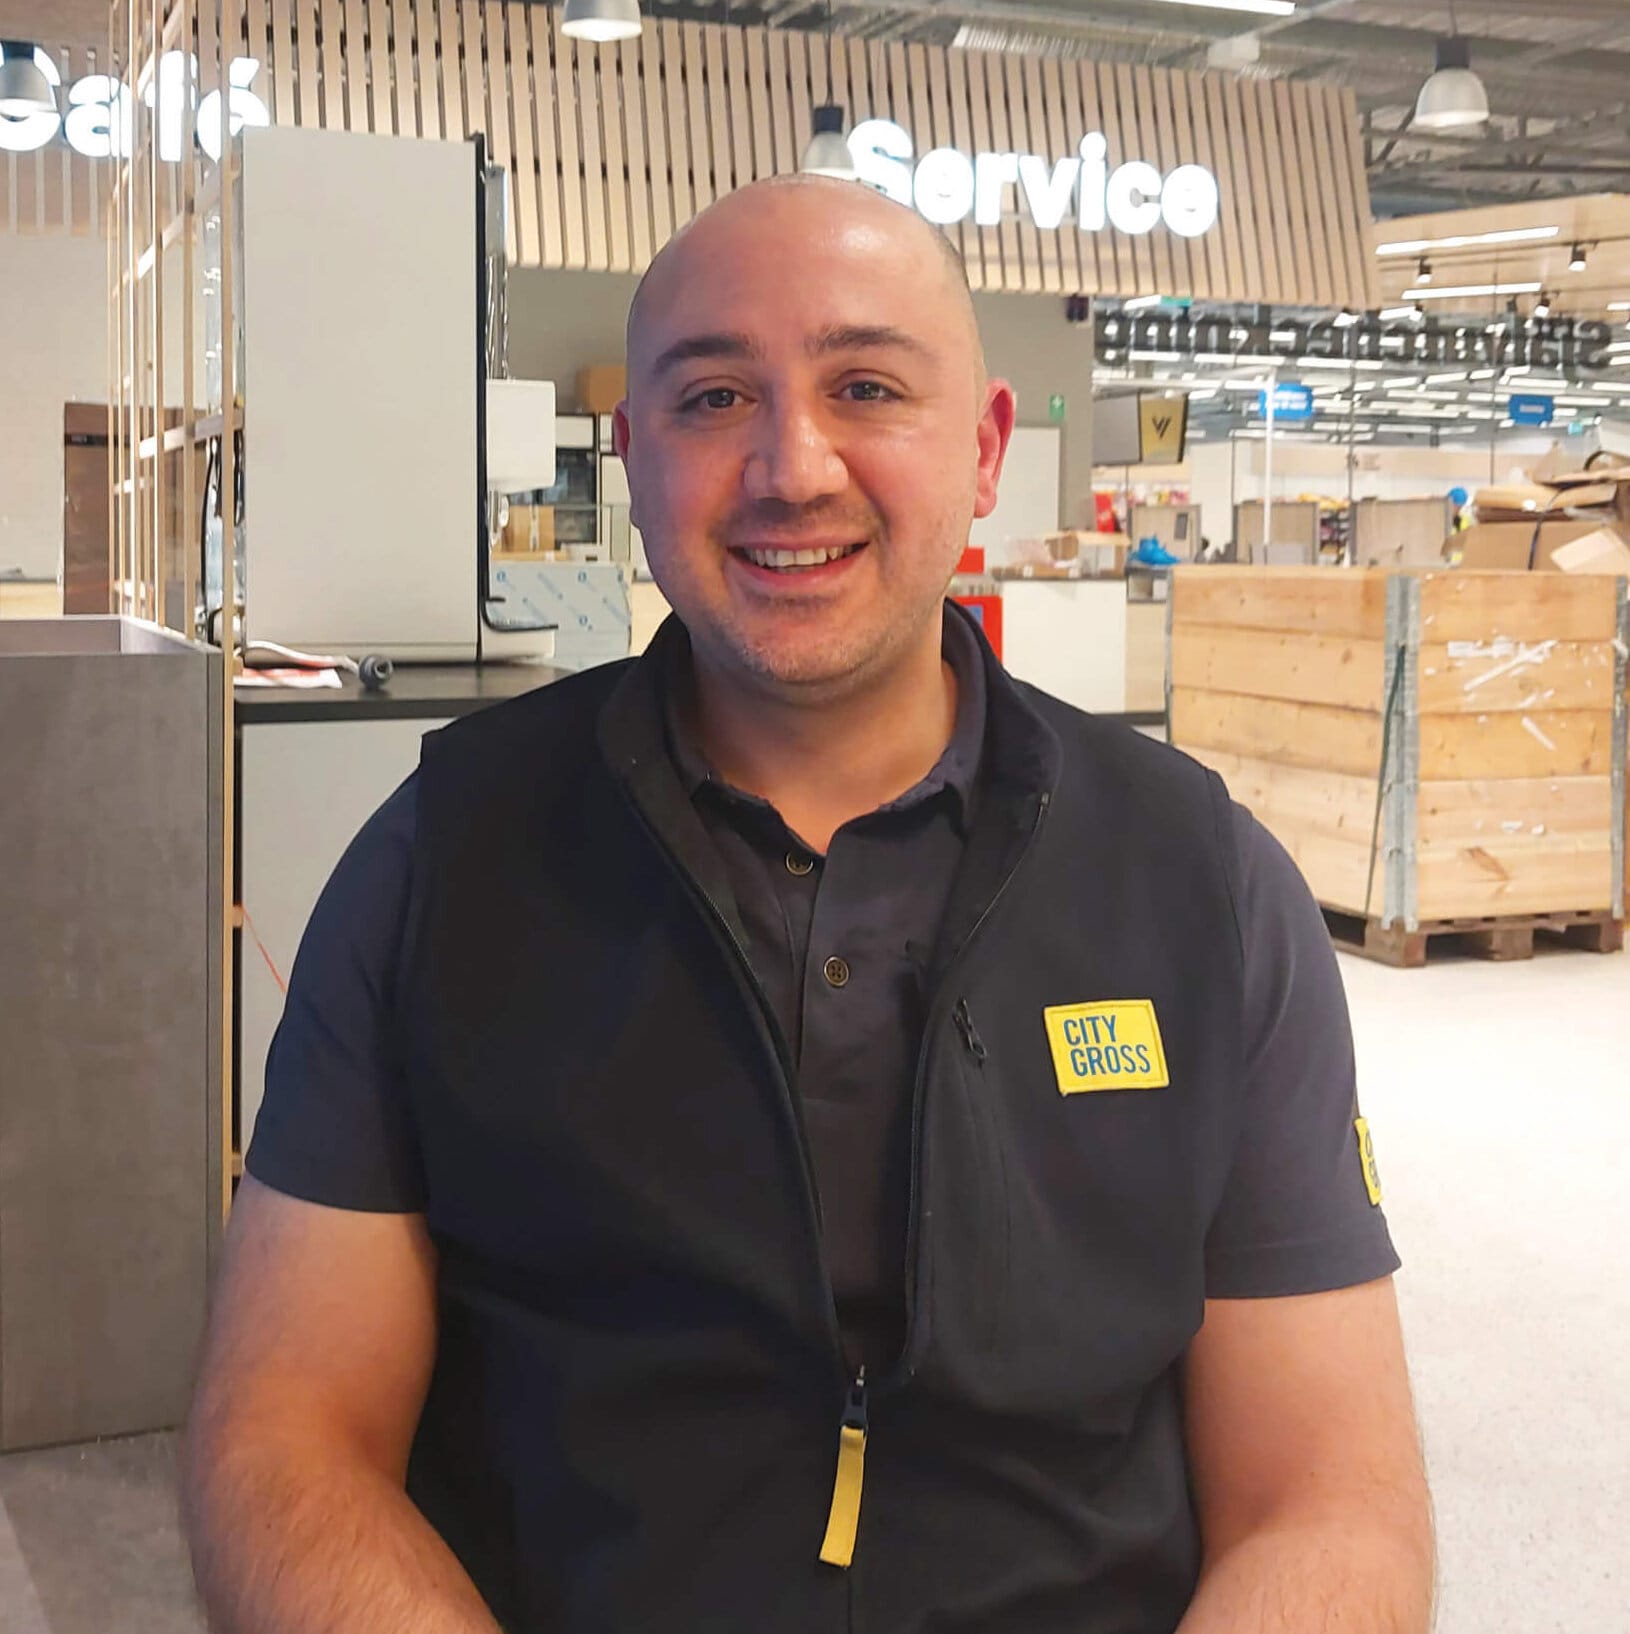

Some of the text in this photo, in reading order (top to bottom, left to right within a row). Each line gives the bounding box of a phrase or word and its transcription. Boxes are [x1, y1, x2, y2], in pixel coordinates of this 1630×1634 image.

[847, 119, 1218, 238] Service
[1063, 1014, 1117, 1046] CITY
[1070, 1044, 1151, 1077] GROSS
